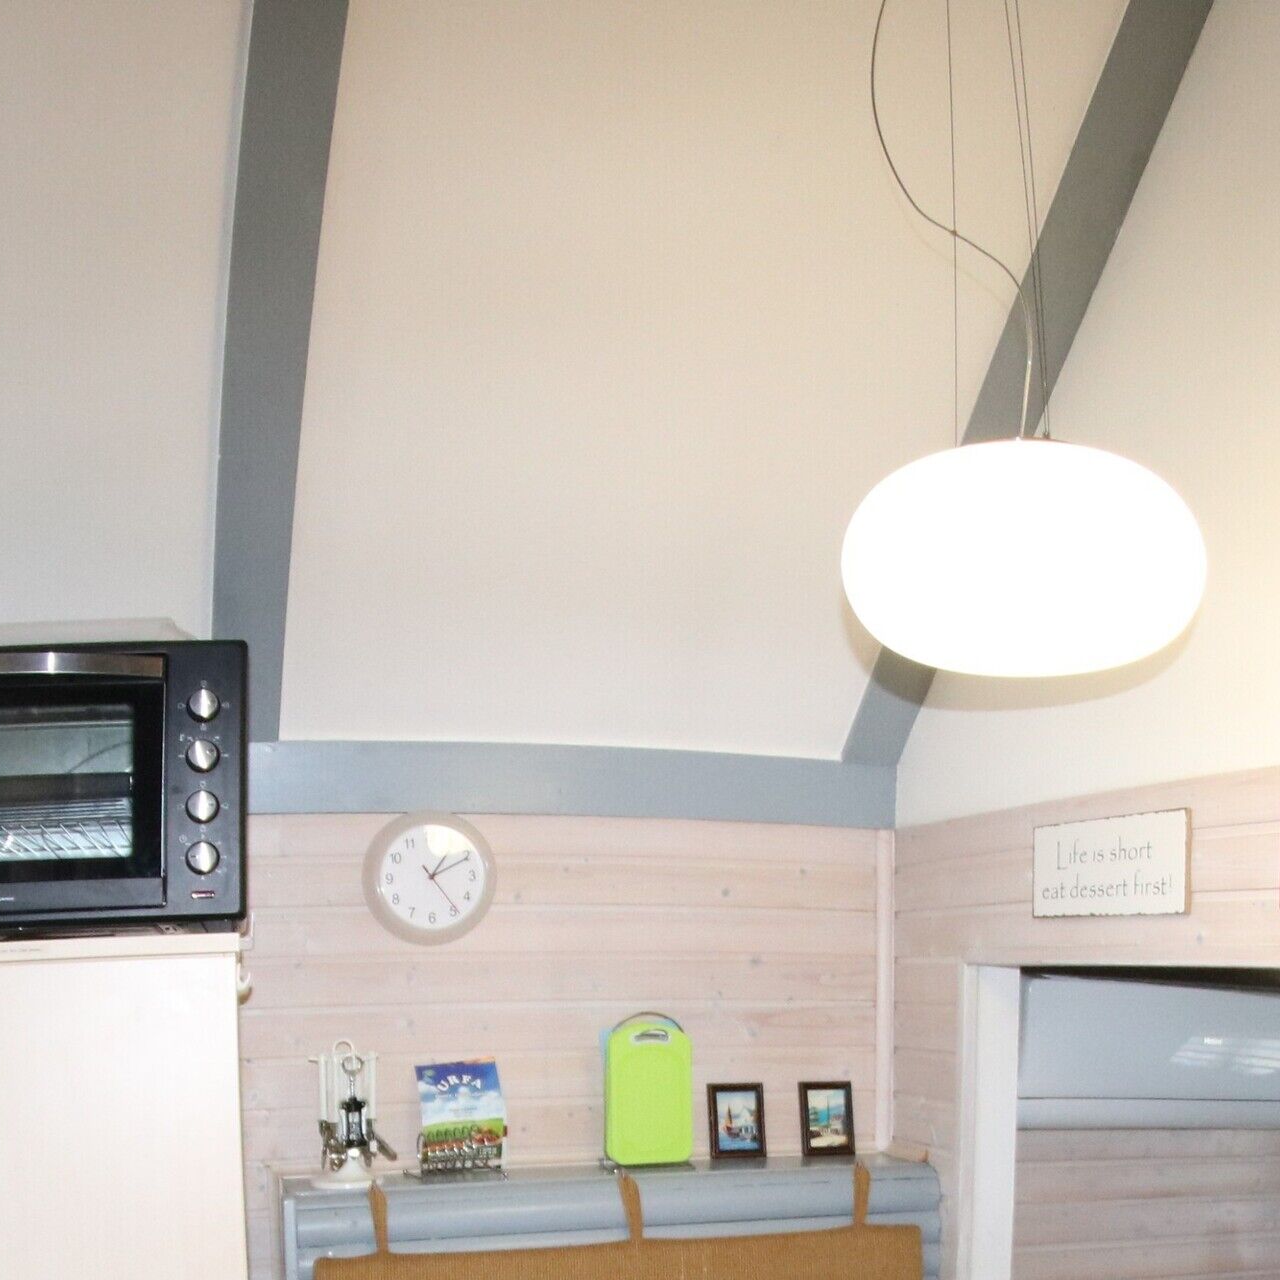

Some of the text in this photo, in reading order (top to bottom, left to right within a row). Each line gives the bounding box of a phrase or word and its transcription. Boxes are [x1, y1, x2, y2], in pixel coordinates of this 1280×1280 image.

[405, 838, 415, 849] 11
[390, 851, 402, 864] 10
[1056, 835, 1152, 870] Life is short
[385, 872, 394, 885] 9
[468, 869, 476, 882] 3
[1041, 868, 1173, 900] eat dessert first!
[391, 893, 400, 905] 8
[463, 891, 470, 901] 4
[408, 906, 416, 918] 7
[428, 912, 436, 924] 6
